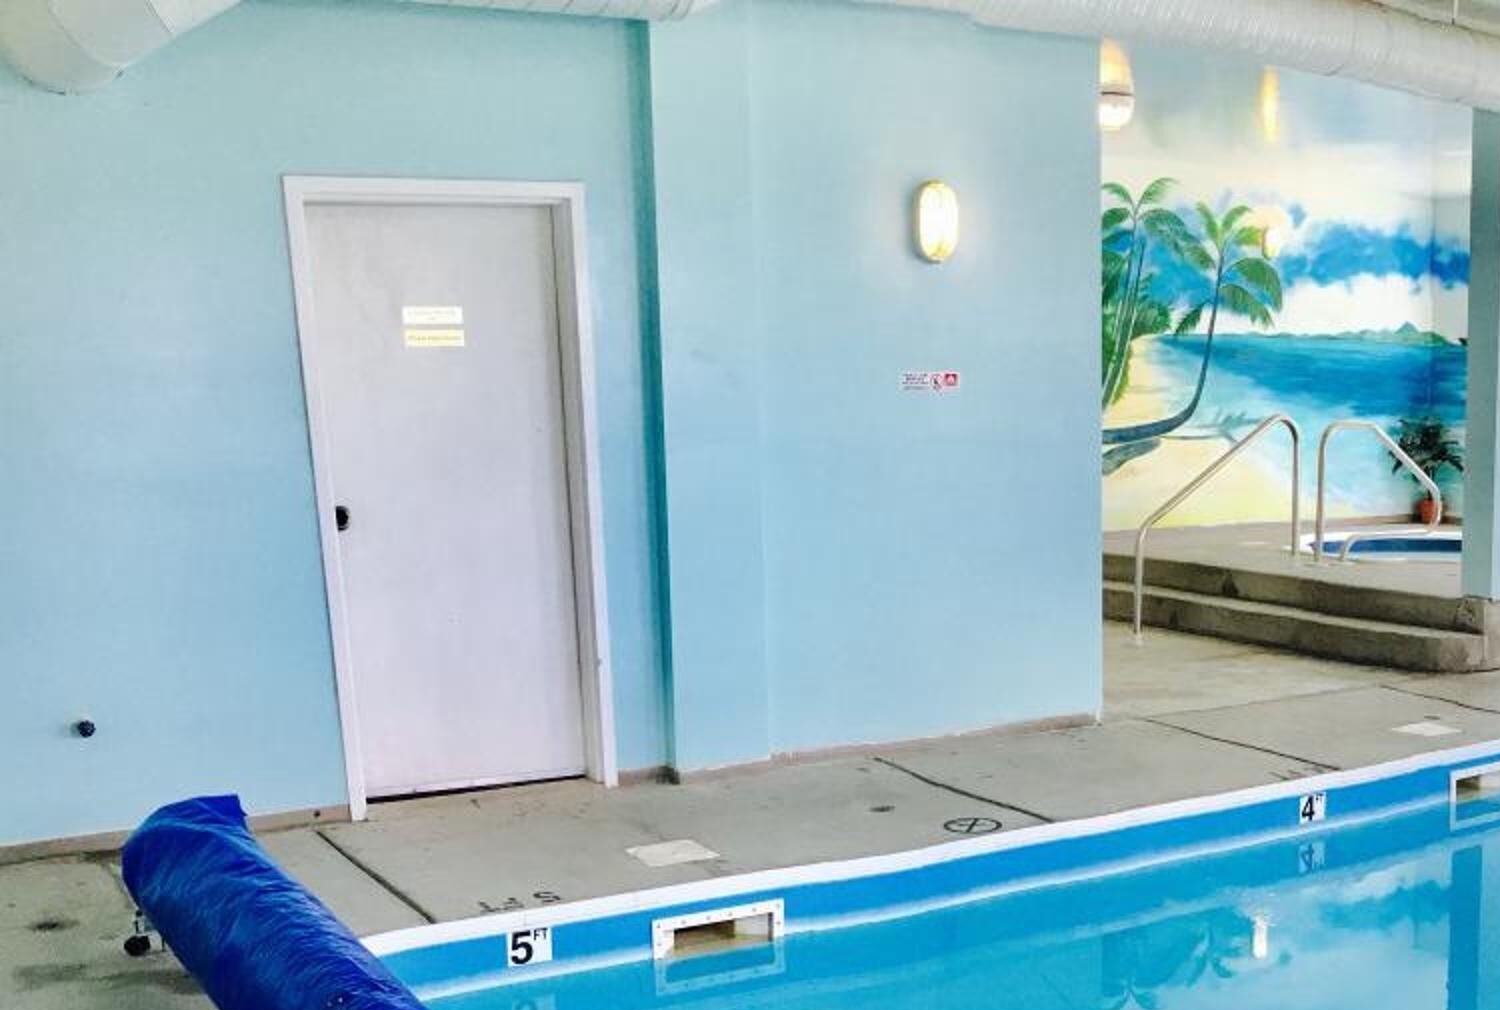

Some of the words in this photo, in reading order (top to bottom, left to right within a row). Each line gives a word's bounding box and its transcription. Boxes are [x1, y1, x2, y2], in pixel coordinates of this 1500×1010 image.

[1301, 795, 1315, 821] 4
[511, 929, 534, 966] 5
[533, 927, 548, 941] FT
